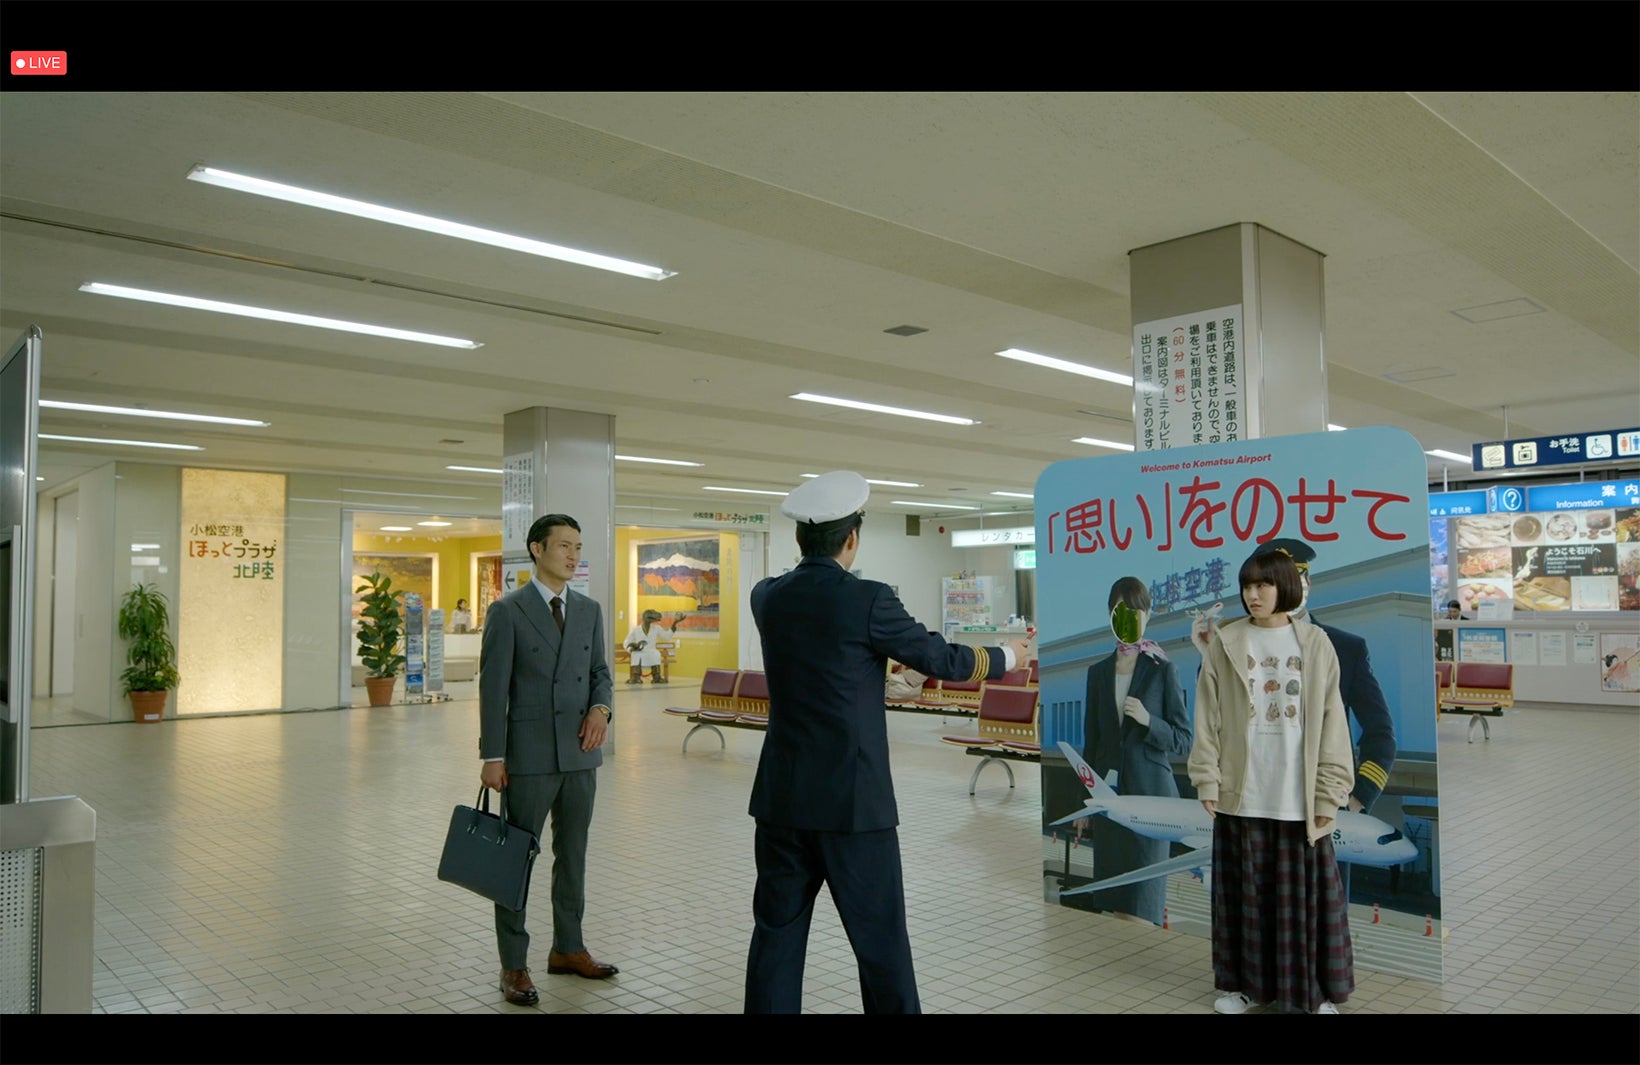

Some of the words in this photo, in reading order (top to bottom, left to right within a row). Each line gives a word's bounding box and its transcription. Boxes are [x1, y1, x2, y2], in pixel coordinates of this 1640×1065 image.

[1188, 324, 1203, 445] 場をご利用頂いておりま
[1549, 437, 1580, 449] お手洗
[1141, 463, 1180, 473] Welcome
[1182, 461, 1191, 469] to
[1193, 458, 1235, 468] Komatsu
[1236, 453, 1272, 465] Airport
[1602, 484, 1639, 497] 案内
[1556, 500, 1604, 508] Information
[1048, 476, 1411, 555] 「思い」をのせて
[190, 524, 244, 537] 小松空港
[982, 531, 1034, 542] レンタカー
[189, 539, 276, 558] ほっとプラザ
[1545, 547, 1601, 555] ようこそ石川へ
[233, 560, 274, 580] 北陸
